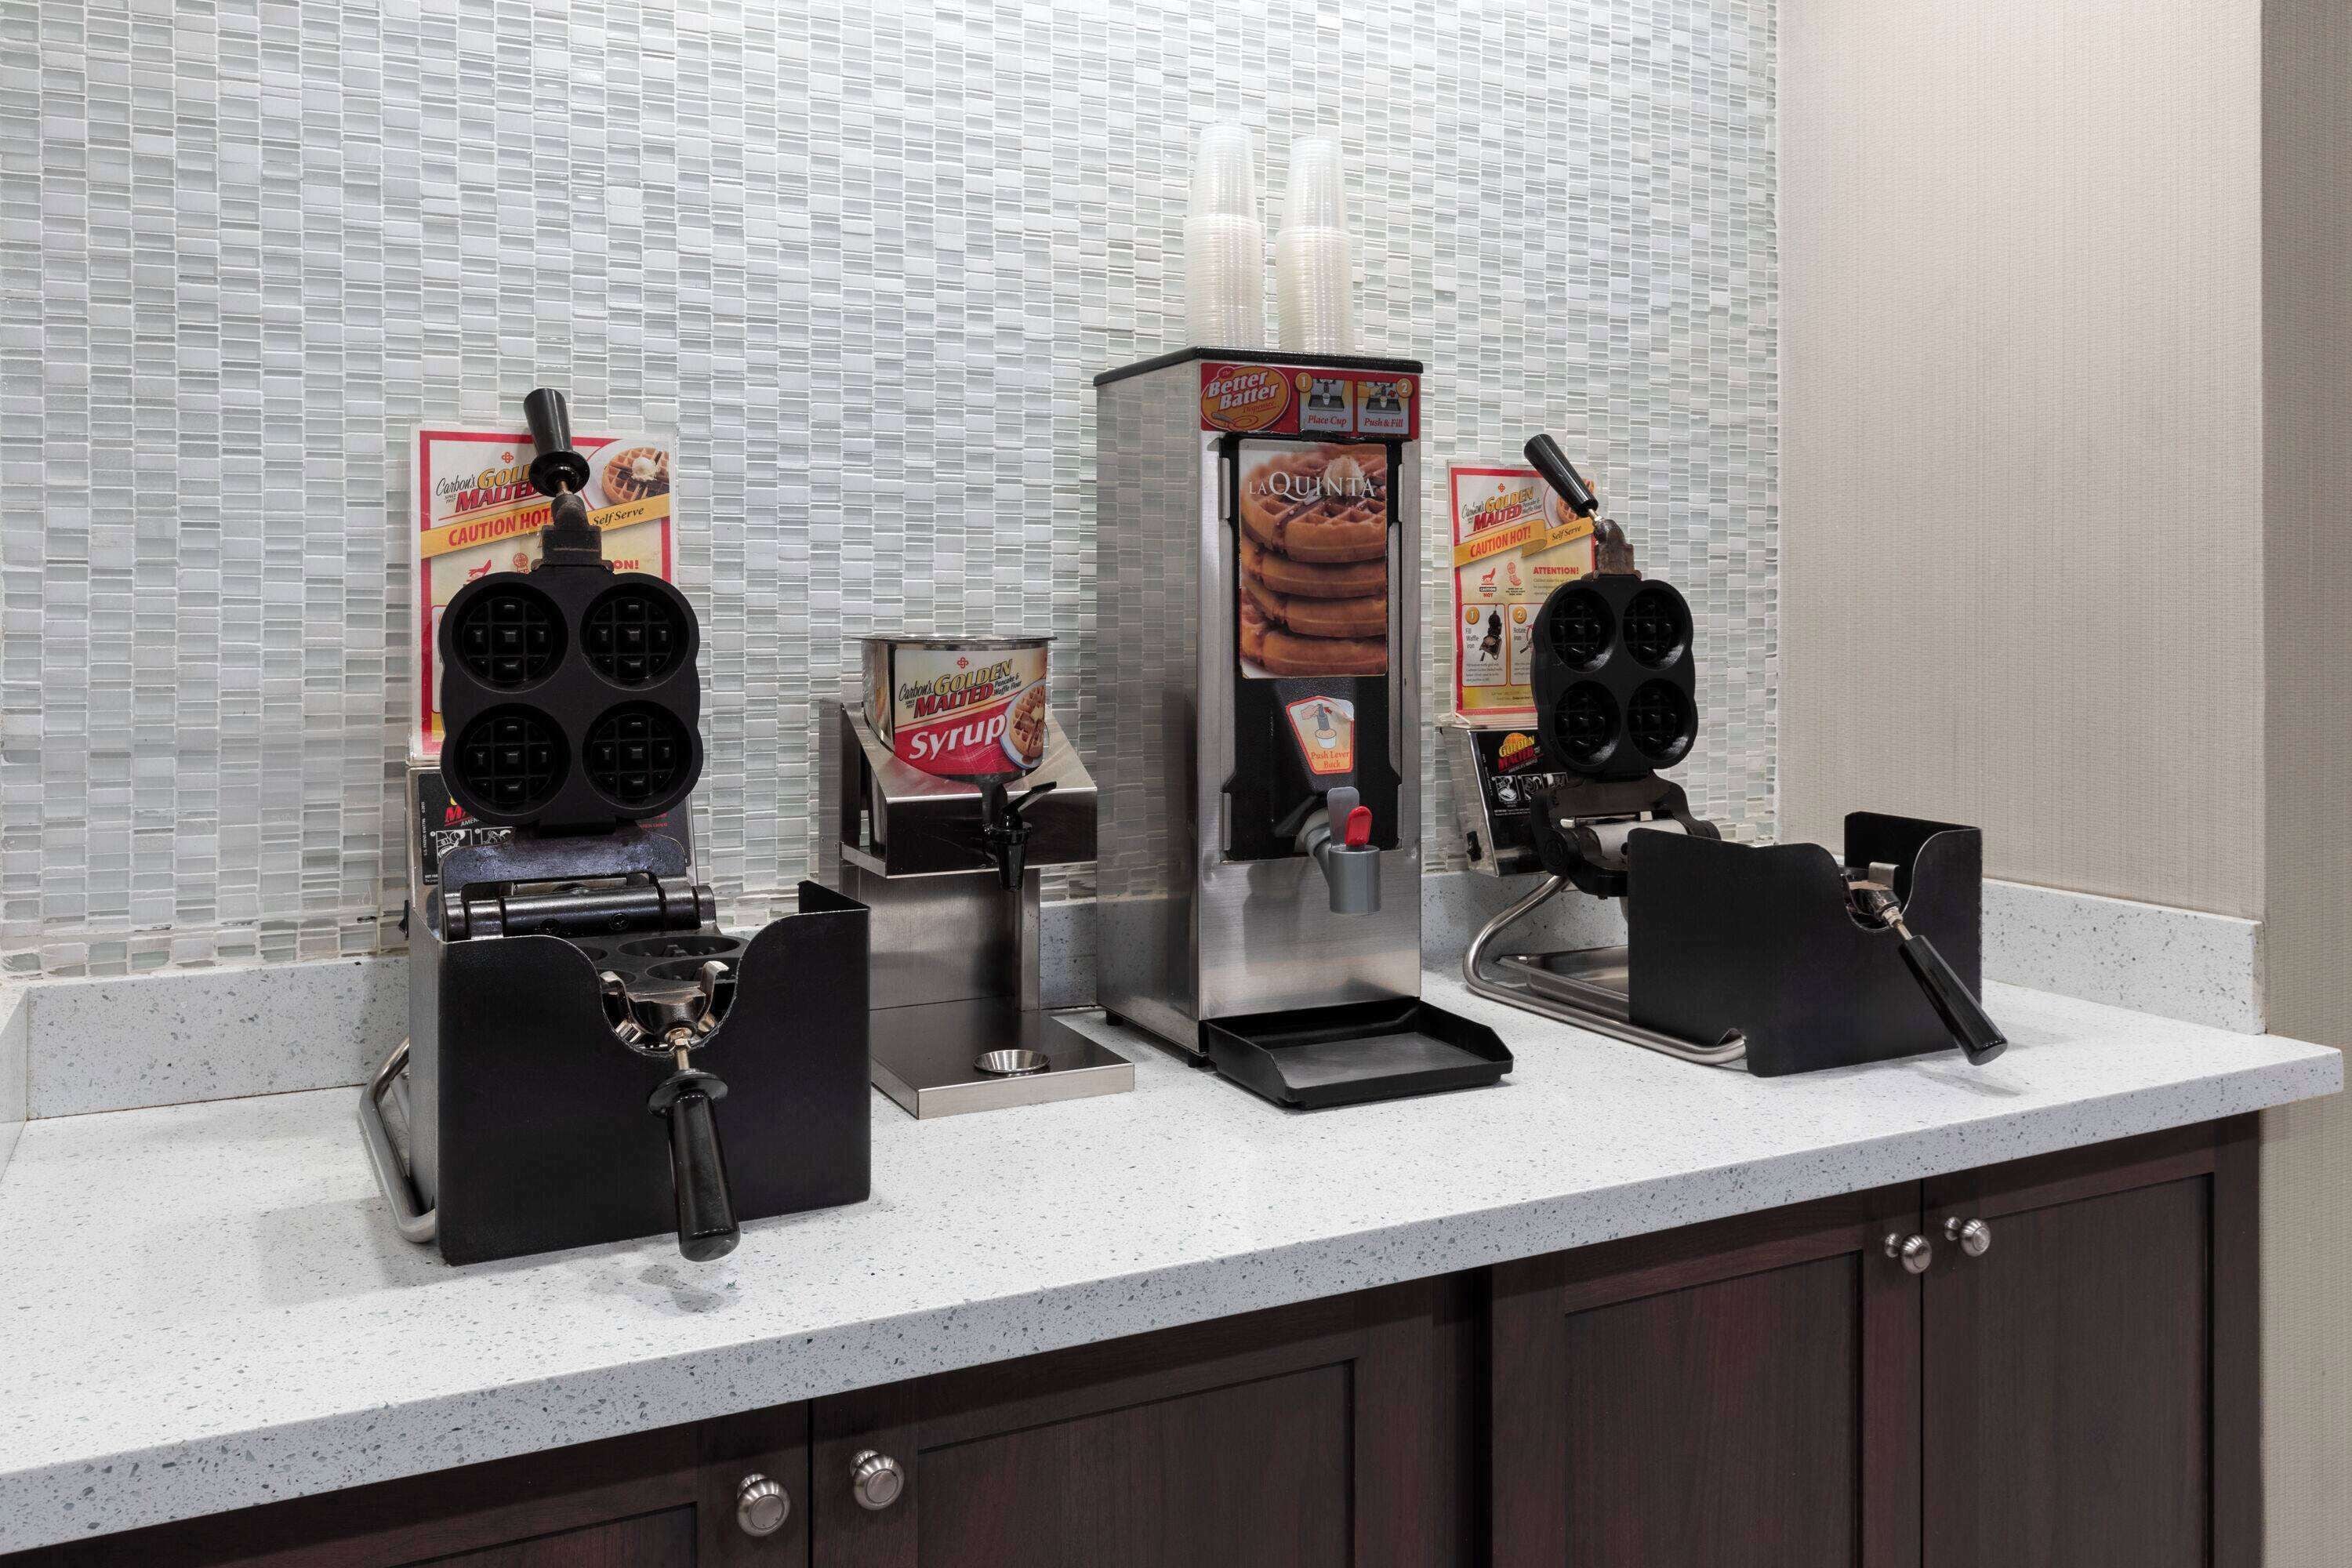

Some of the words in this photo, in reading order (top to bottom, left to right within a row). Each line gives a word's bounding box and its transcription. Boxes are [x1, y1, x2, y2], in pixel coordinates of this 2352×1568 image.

[1207, 371, 1269, 398] Better
[1301, 376, 1307, 387] 1
[1400, 383, 1409, 393] 2
[1219, 383, 1279, 411] Batter
[1308, 415, 1329, 425] Place
[1330, 416, 1347, 426] Cup
[1364, 417, 1382, 427] Push
[1390, 418, 1404, 428] Fill
[436, 474, 477, 496] Carbon's
[1249, 481, 1268, 495] LA
[1269, 470, 1377, 502] QUINTA
[1484, 486, 1534, 514] GOLDEN
[448, 515, 517, 546] CAUTION
[520, 508, 552, 531] HOT
[593, 512, 615, 526] Self
[615, 507, 644, 521] Serve
[1473, 504, 1523, 532] MALTED
[1469, 533, 1508, 558] CAUTION
[1510, 525, 1531, 545] HOT!
[1552, 528, 1564, 541] Self
[1564, 525, 1581, 537] Serve
[1533, 566, 1579, 575] ATTENTION!
[898, 681, 934, 702] Carbon's
[933, 659, 1013, 697] GOLDEN
[913, 682, 994, 719] MALTED
[908, 713, 1007, 761] Syrup
[1311, 750, 1329, 760] Push
[1330, 750, 1349, 760] Lever
[1323, 760, 1341, 768] Back
